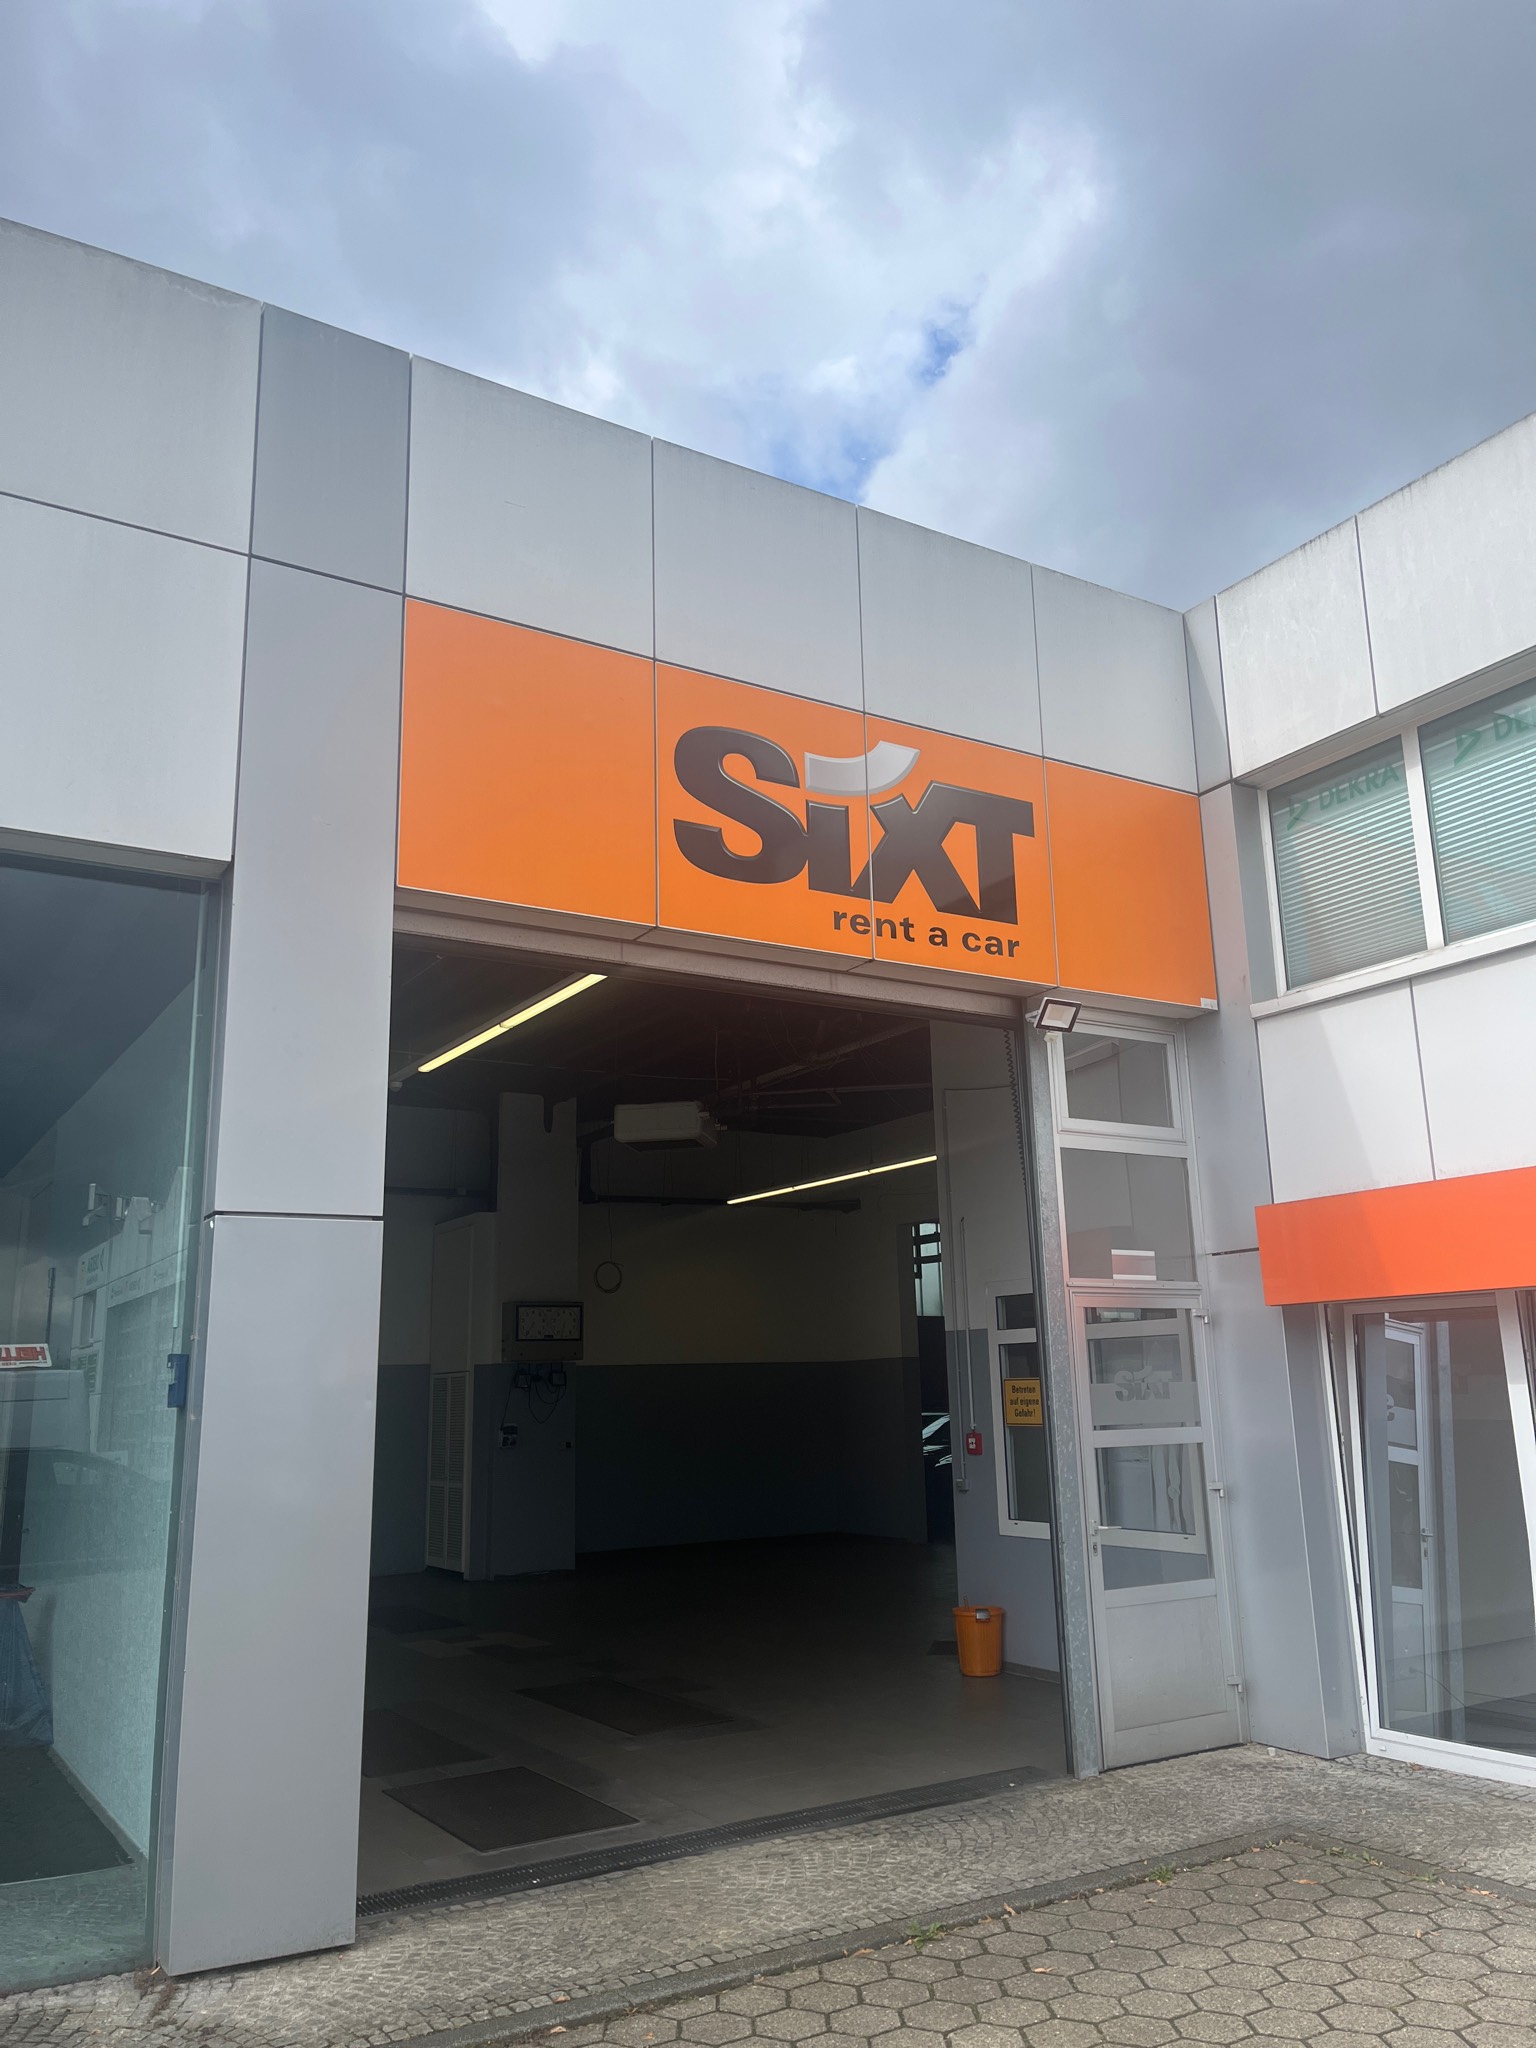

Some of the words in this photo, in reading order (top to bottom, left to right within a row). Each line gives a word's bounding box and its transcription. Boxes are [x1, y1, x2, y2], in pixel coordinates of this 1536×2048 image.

[1318, 761, 1401, 812] DEKRA
[832, 910, 916, 943] rent
[928, 926, 949, 948] a
[961, 931, 1021, 958] car
[1011, 1384, 1036, 1394] Betreten
[1009, 1396, 1019, 1406] auf
[1019, 1397, 1040, 1407] eigene
[1014, 1408, 1036, 1418] Gefahr!
